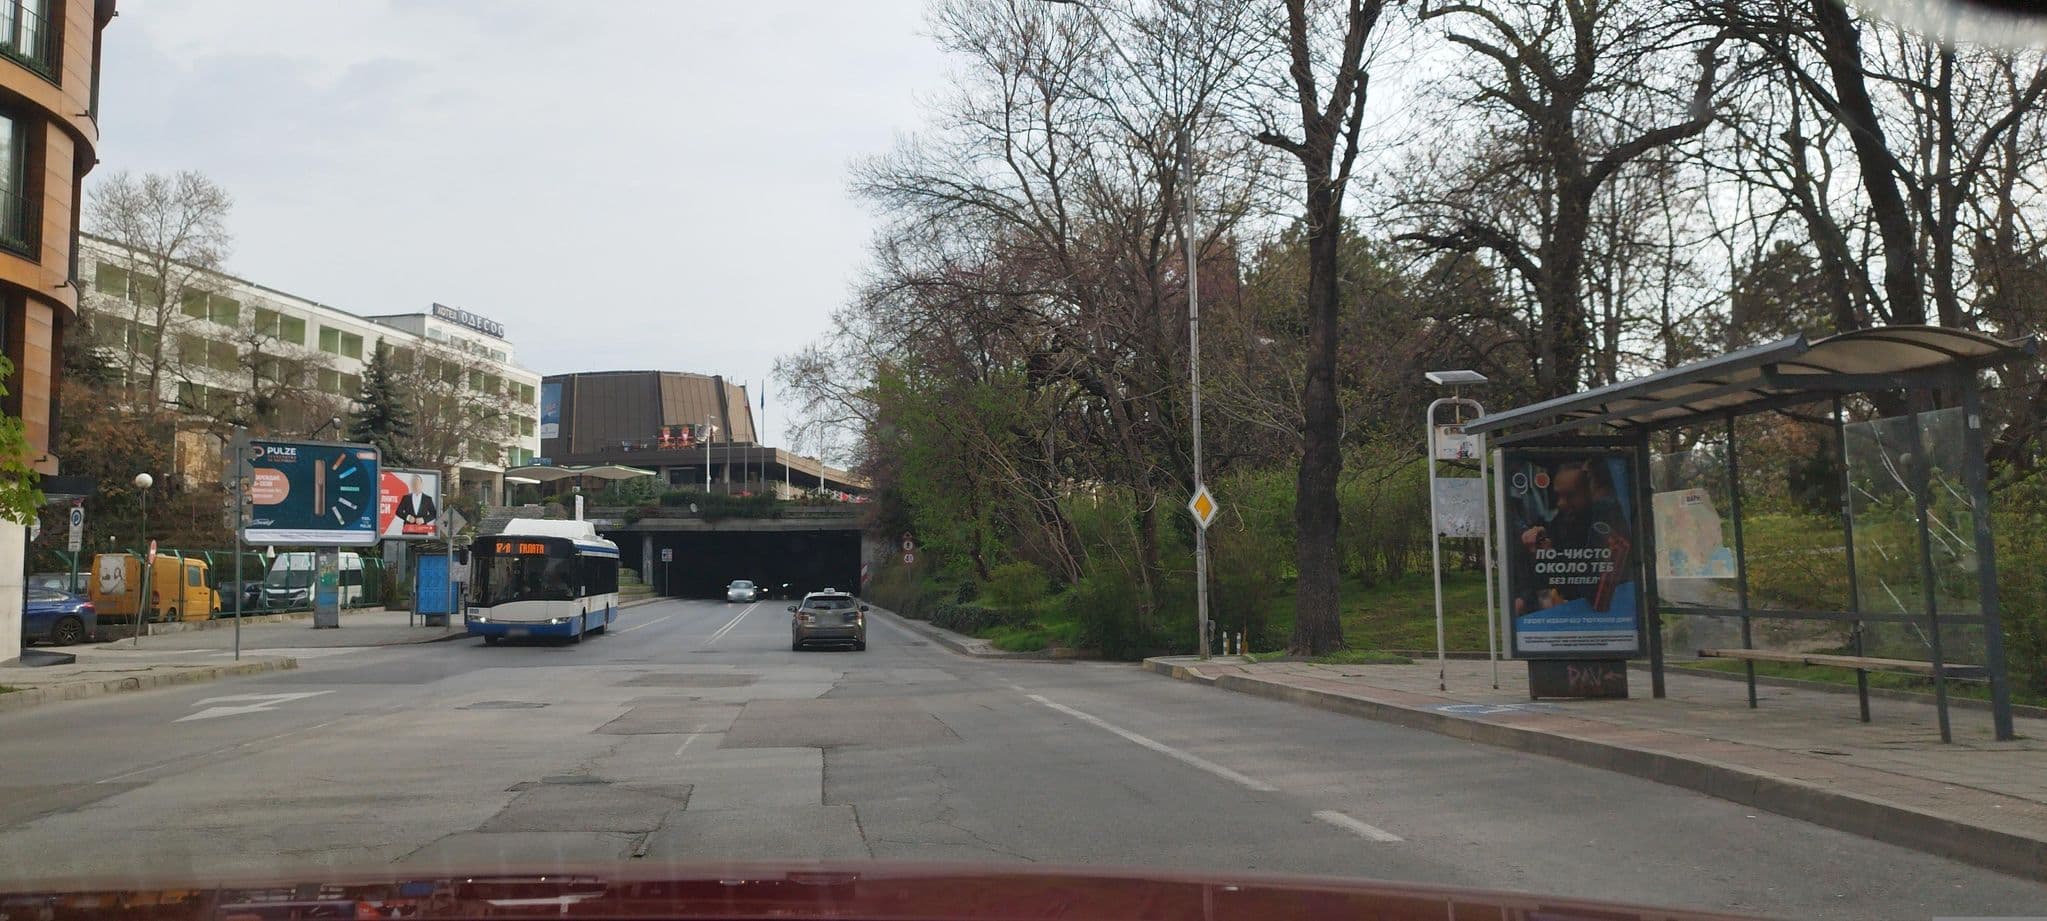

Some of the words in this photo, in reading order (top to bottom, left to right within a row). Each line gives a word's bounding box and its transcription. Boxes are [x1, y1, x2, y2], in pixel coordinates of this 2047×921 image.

[267, 446, 297, 456] PULZE
[1512, 463, 1550, 495] glo
[1535, 548, 1612, 560] ПО-ЧИСТО
[1535, 562, 1588, 573] ОКОЛО
[1591, 562, 1615, 573] ТЕБ
[1549, 577, 1567, 585] БЕЗ
